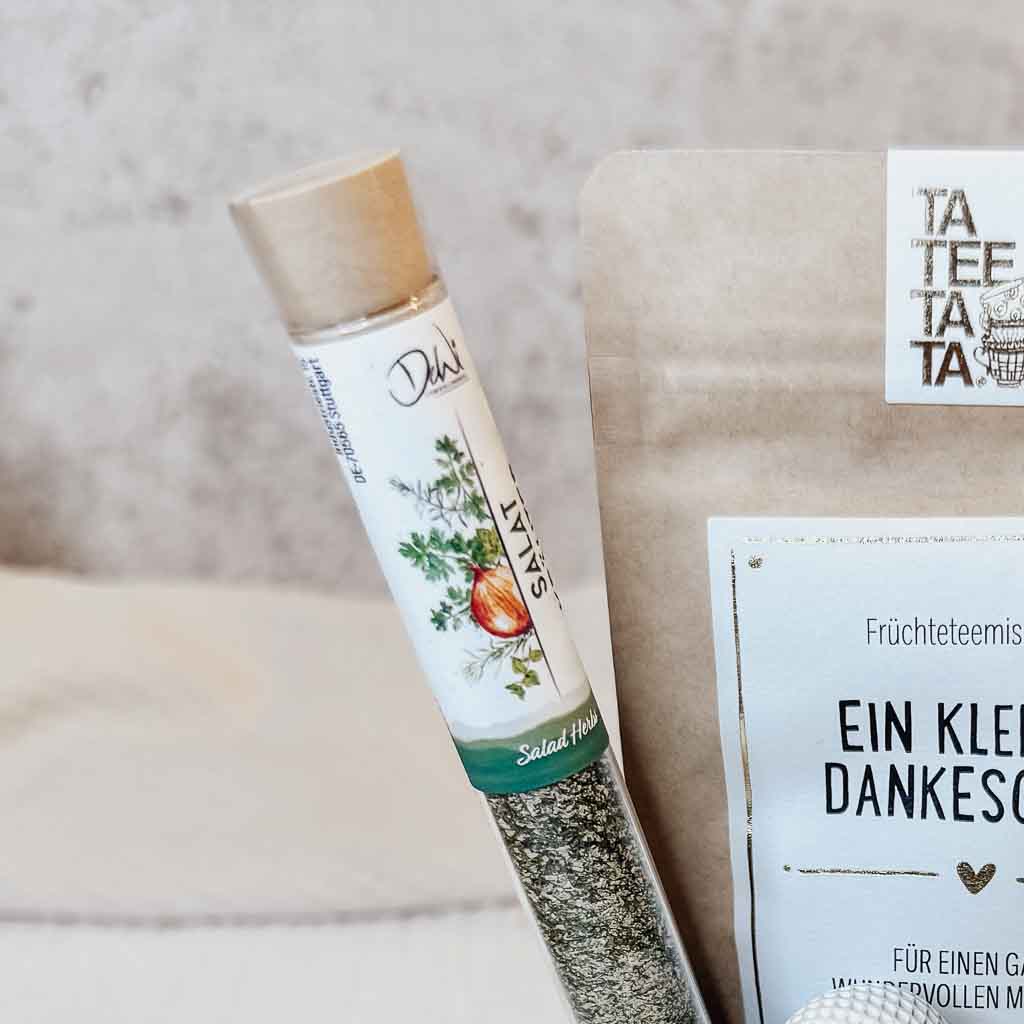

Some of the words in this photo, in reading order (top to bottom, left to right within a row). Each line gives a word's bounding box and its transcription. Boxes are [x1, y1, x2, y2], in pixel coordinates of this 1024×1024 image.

[911, 187, 977, 235] TA
[911, 240, 1016, 286] TEE
[911, 290, 975, 337] TA
[910, 341, 975, 387] TA
[309, 358, 341, 419] Stuttgart
[500, 499, 548, 599] SALAT
[516, 728, 569, 766] Salad
[838, 700, 912, 753] EIN
[893, 943, 932, 974] FÜR
[939, 950, 998, 976] EINEN
